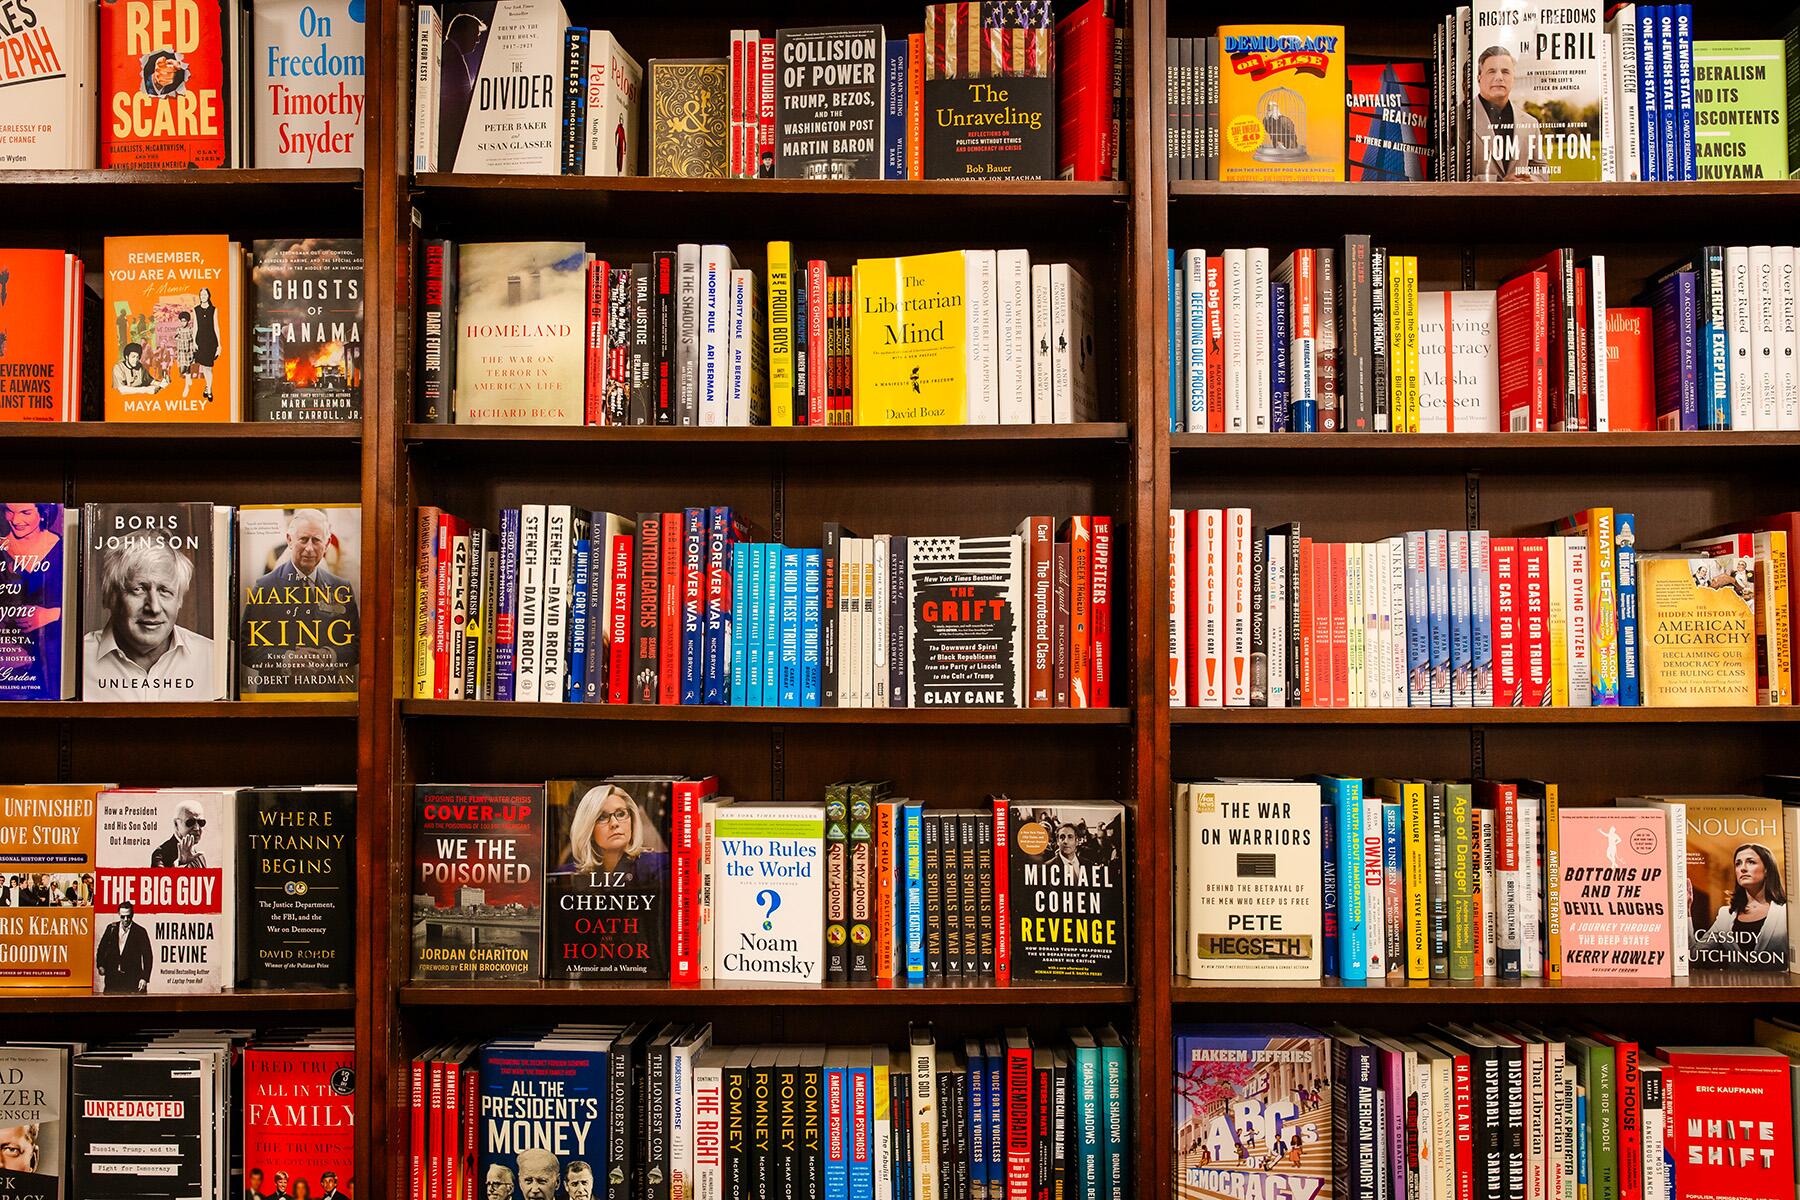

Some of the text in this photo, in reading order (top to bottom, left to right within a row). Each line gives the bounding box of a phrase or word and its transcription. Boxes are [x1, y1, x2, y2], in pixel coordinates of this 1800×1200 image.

[1479, 8, 1596, 27] RIGHTS AND FREEDOMS
[127, 1, 199, 56] RED
[783, 39, 876, 63] COLLISION
[1224, 35, 1338, 53] DEMOCRACY
[1520, 32, 1596, 60] IN PERIL
[268, 44, 365, 77] Freedom
[762, 43, 773, 118] DEAD DOUBLES
[784, 63, 875, 87] OF POWER
[480, 75, 552, 110] DIVIDER
[589, 64, 604, 108] Pelosi
[969, 84, 1008, 103] The
[269, 83, 365, 124] Timothy
[784, 91, 875, 110] TRUMP, BEZOS,
[1346, 94, 1401, 107] CAPITALIST
[112, 90, 218, 138] SCARE
[937, 107, 1041, 129] Unraveling
[1382, 107, 1428, 129] REALISM
[484, 122, 547, 132] PETER BAKER
[784, 120, 873, 135] WASHINGTON POST
[279, 122, 354, 163] Snyder
[510, 141, 552, 149] GLASSER
[1482, 134, 1596, 161] TOM FITTON,
[967, 164, 1011, 174] Bob Bauer
[273, 280, 358, 299] GHOSTS
[864, 293, 962, 313] Libertarian
[467, 324, 572, 338] HOMELAND
[773, 289, 787, 353] PROUD BOYS
[272, 323, 361, 343] PANAMA
[885, 321, 944, 345] Mind
[1711, 269, 1726, 398] AMERICAN EXCEPTION
[1191, 293, 1204, 411] DEFENDING DUE PROCESS
[10, 380, 50, 394] ALWAYS
[474, 382, 562, 391] AMERICAN LIFE
[281, 400, 351, 408] MARK HARMON
[887, 408, 945, 419] David Boaz
[270, 411, 362, 420] LEON CARROLL, JR.
[641, 520, 658, 627] CONTROLIGARCHS
[688, 536, 699, 597] FOREVER
[1093, 535, 1108, 604] PUPPETEERS
[246, 586, 352, 605] MAKING
[614, 553, 626, 643] HATE NEXT DOOR
[1035, 525, 1049, 670] Carl The Unprotected Class
[686, 601, 697, 632] WAR
[922, 600, 1005, 622] GRIFT
[1498, 557, 1513, 684] THE CASE FOR TRUMP
[248, 619, 354, 647] KING
[1658, 620, 1746, 631] AMERICAN
[1654, 633, 1751, 644] OLIGARCHY
[99, 678, 194, 689] UNLEASHED
[924, 692, 1004, 704] CLAY CANE
[5, 799, 93, 817] UNFINISHED
[1221, 803, 1291, 818] THE WAR
[260, 811, 332, 827] WHERE
[249, 835, 345, 850] TYRANNY
[1202, 829, 1311, 845] ON WARRIORS
[437, 839, 516, 859] WE THE
[262, 860, 332, 874] BEGINS
[1365, 837, 1381, 886] OWNED
[421, 864, 531, 883] POISONED
[1025, 864, 1113, 887] MICHAEL
[101, 875, 215, 905] THE BIG GUY
[1207, 884, 1234, 892] BEHIND
[1238, 884, 1251, 892] THE
[1254, 884, 1291, 892] BETRAYAL
[273, 901, 293, 909] Justice
[294, 901, 335, 910] Department,
[560, 894, 655, 910] CHENEY
[1564, 902, 1664, 915] DEVIL LAUGHS
[291, 926, 327, 934] Democracy
[575, 918, 639, 933] OATH
[1021, 918, 1117, 945] REVENGE
[740, 933, 797, 951] Noam
[1211, 938, 1300, 954] HEGSETH
[1695, 930, 1761, 944] CASSIDY
[563, 944, 650, 958] HONOR
[724, 953, 814, 978] Chomsky
[1192, 1050, 1312, 1062] HAKEEM JEFFRIES
[1458, 1065, 1469, 1141] HATELAND
[1509, 1060, 1522, 1128] DISPOSABLE
[87, 1102, 183, 1117] UNREDACTED
[482, 1096, 597, 1119] PRESIDENT'S
[730, 1075, 742, 1152] ROMNEY
[489, 1120, 591, 1155] MONEY
[1688, 1119, 1774, 1140] WHITE
[1689, 1146, 1774, 1168] SHIFT
